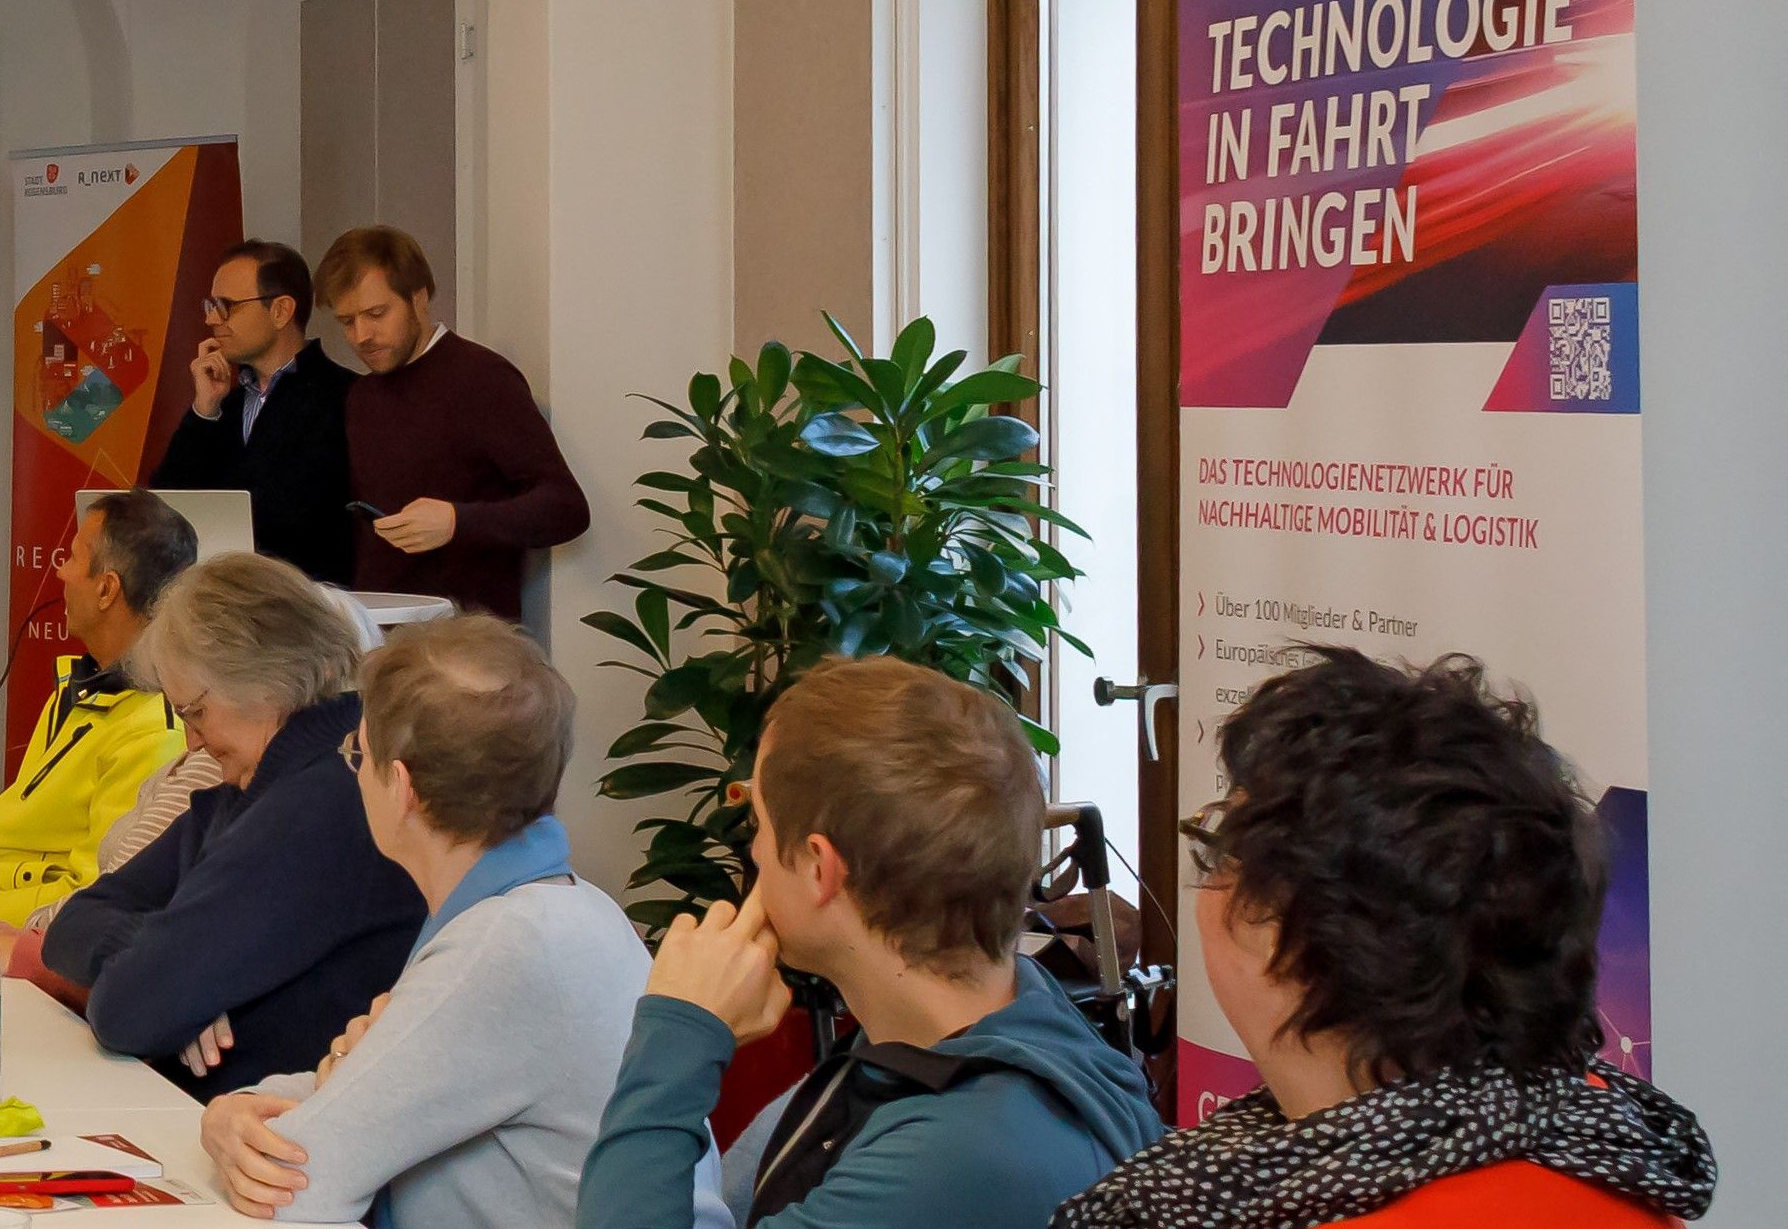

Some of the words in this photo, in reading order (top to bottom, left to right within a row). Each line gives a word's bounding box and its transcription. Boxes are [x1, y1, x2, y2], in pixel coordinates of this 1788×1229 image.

[1206, 108, 1251, 185] IN
[1267, 84, 1430, 178] FAHRT
[1201, 185, 1417, 274] BRINGEN
[1199, 458, 1228, 485] DAS
[1233, 459, 1467, 497] TECHNOLOGIENETZWERK
[1474, 462, 1514, 499] FÜR
[1199, 500, 1313, 533] NACHHALTIGE
[1318, 504, 1419, 540] MOBILITÄT
[1423, 513, 1437, 541] &
[1443, 514, 1539, 548] LOGISTIK
[1216, 592, 1249, 618] Über
[1255, 600, 1279, 621] 100
[1284, 603, 1347, 629] Mitglieder
[1352, 610, 1362, 630] &
[1369, 611, 1417, 637] Partner
